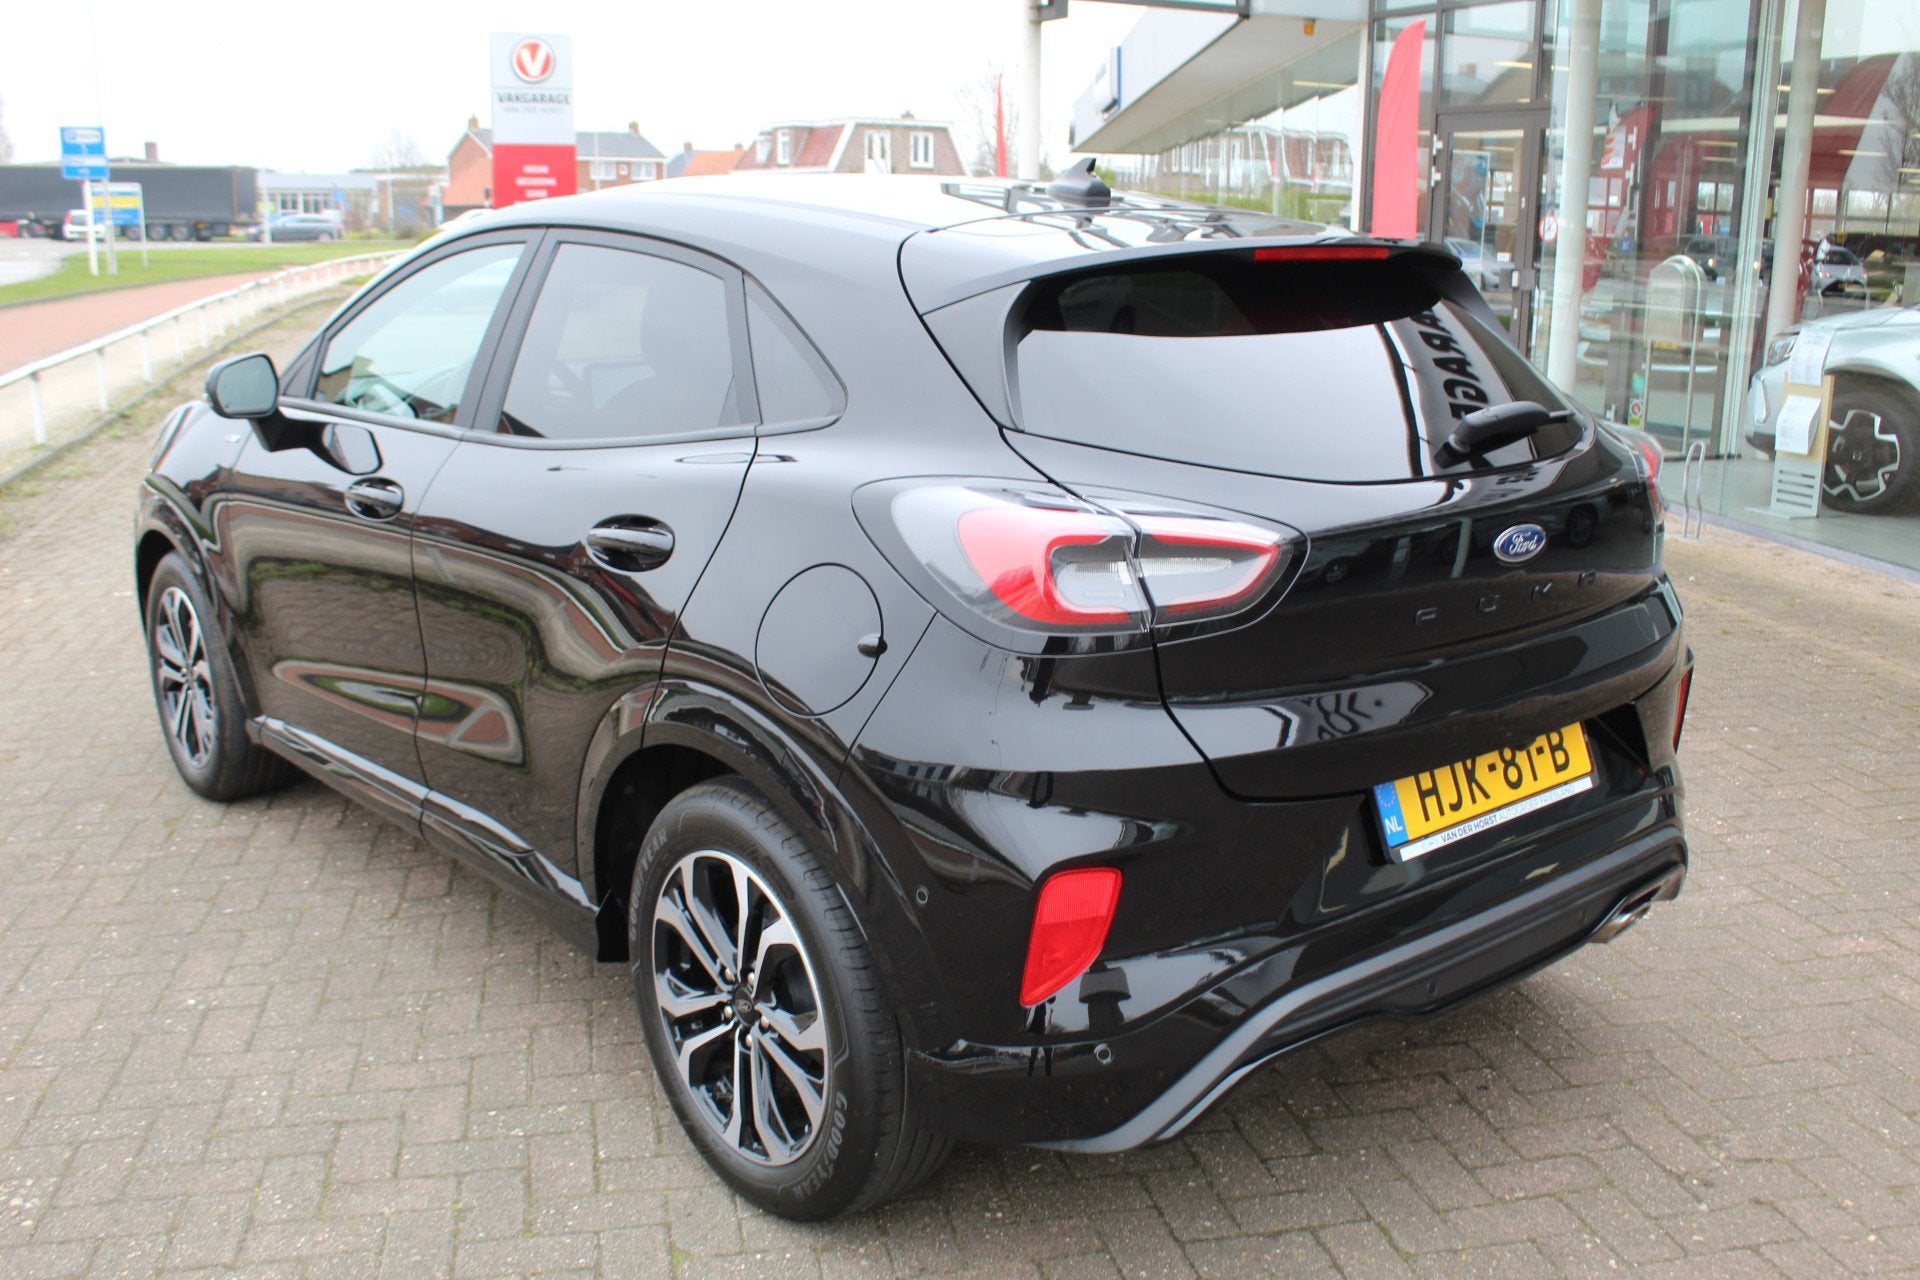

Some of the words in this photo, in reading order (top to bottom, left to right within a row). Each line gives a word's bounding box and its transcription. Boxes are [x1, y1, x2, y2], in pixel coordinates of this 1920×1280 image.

[497, 92, 570, 104] VAKGARAGE
[1509, 531, 1539, 556] Ford
[1414, 568, 1597, 626] PUMA
[1414, 729, 1570, 822] HJK-81-B
[1385, 816, 1403, 834] NL
[1441, 830, 1458, 843] VAN
[1459, 824, 1474, 838] DER
[1474, 815, 1499, 830] HORST
[793, 1091, 848, 1202] GOODYEAR
